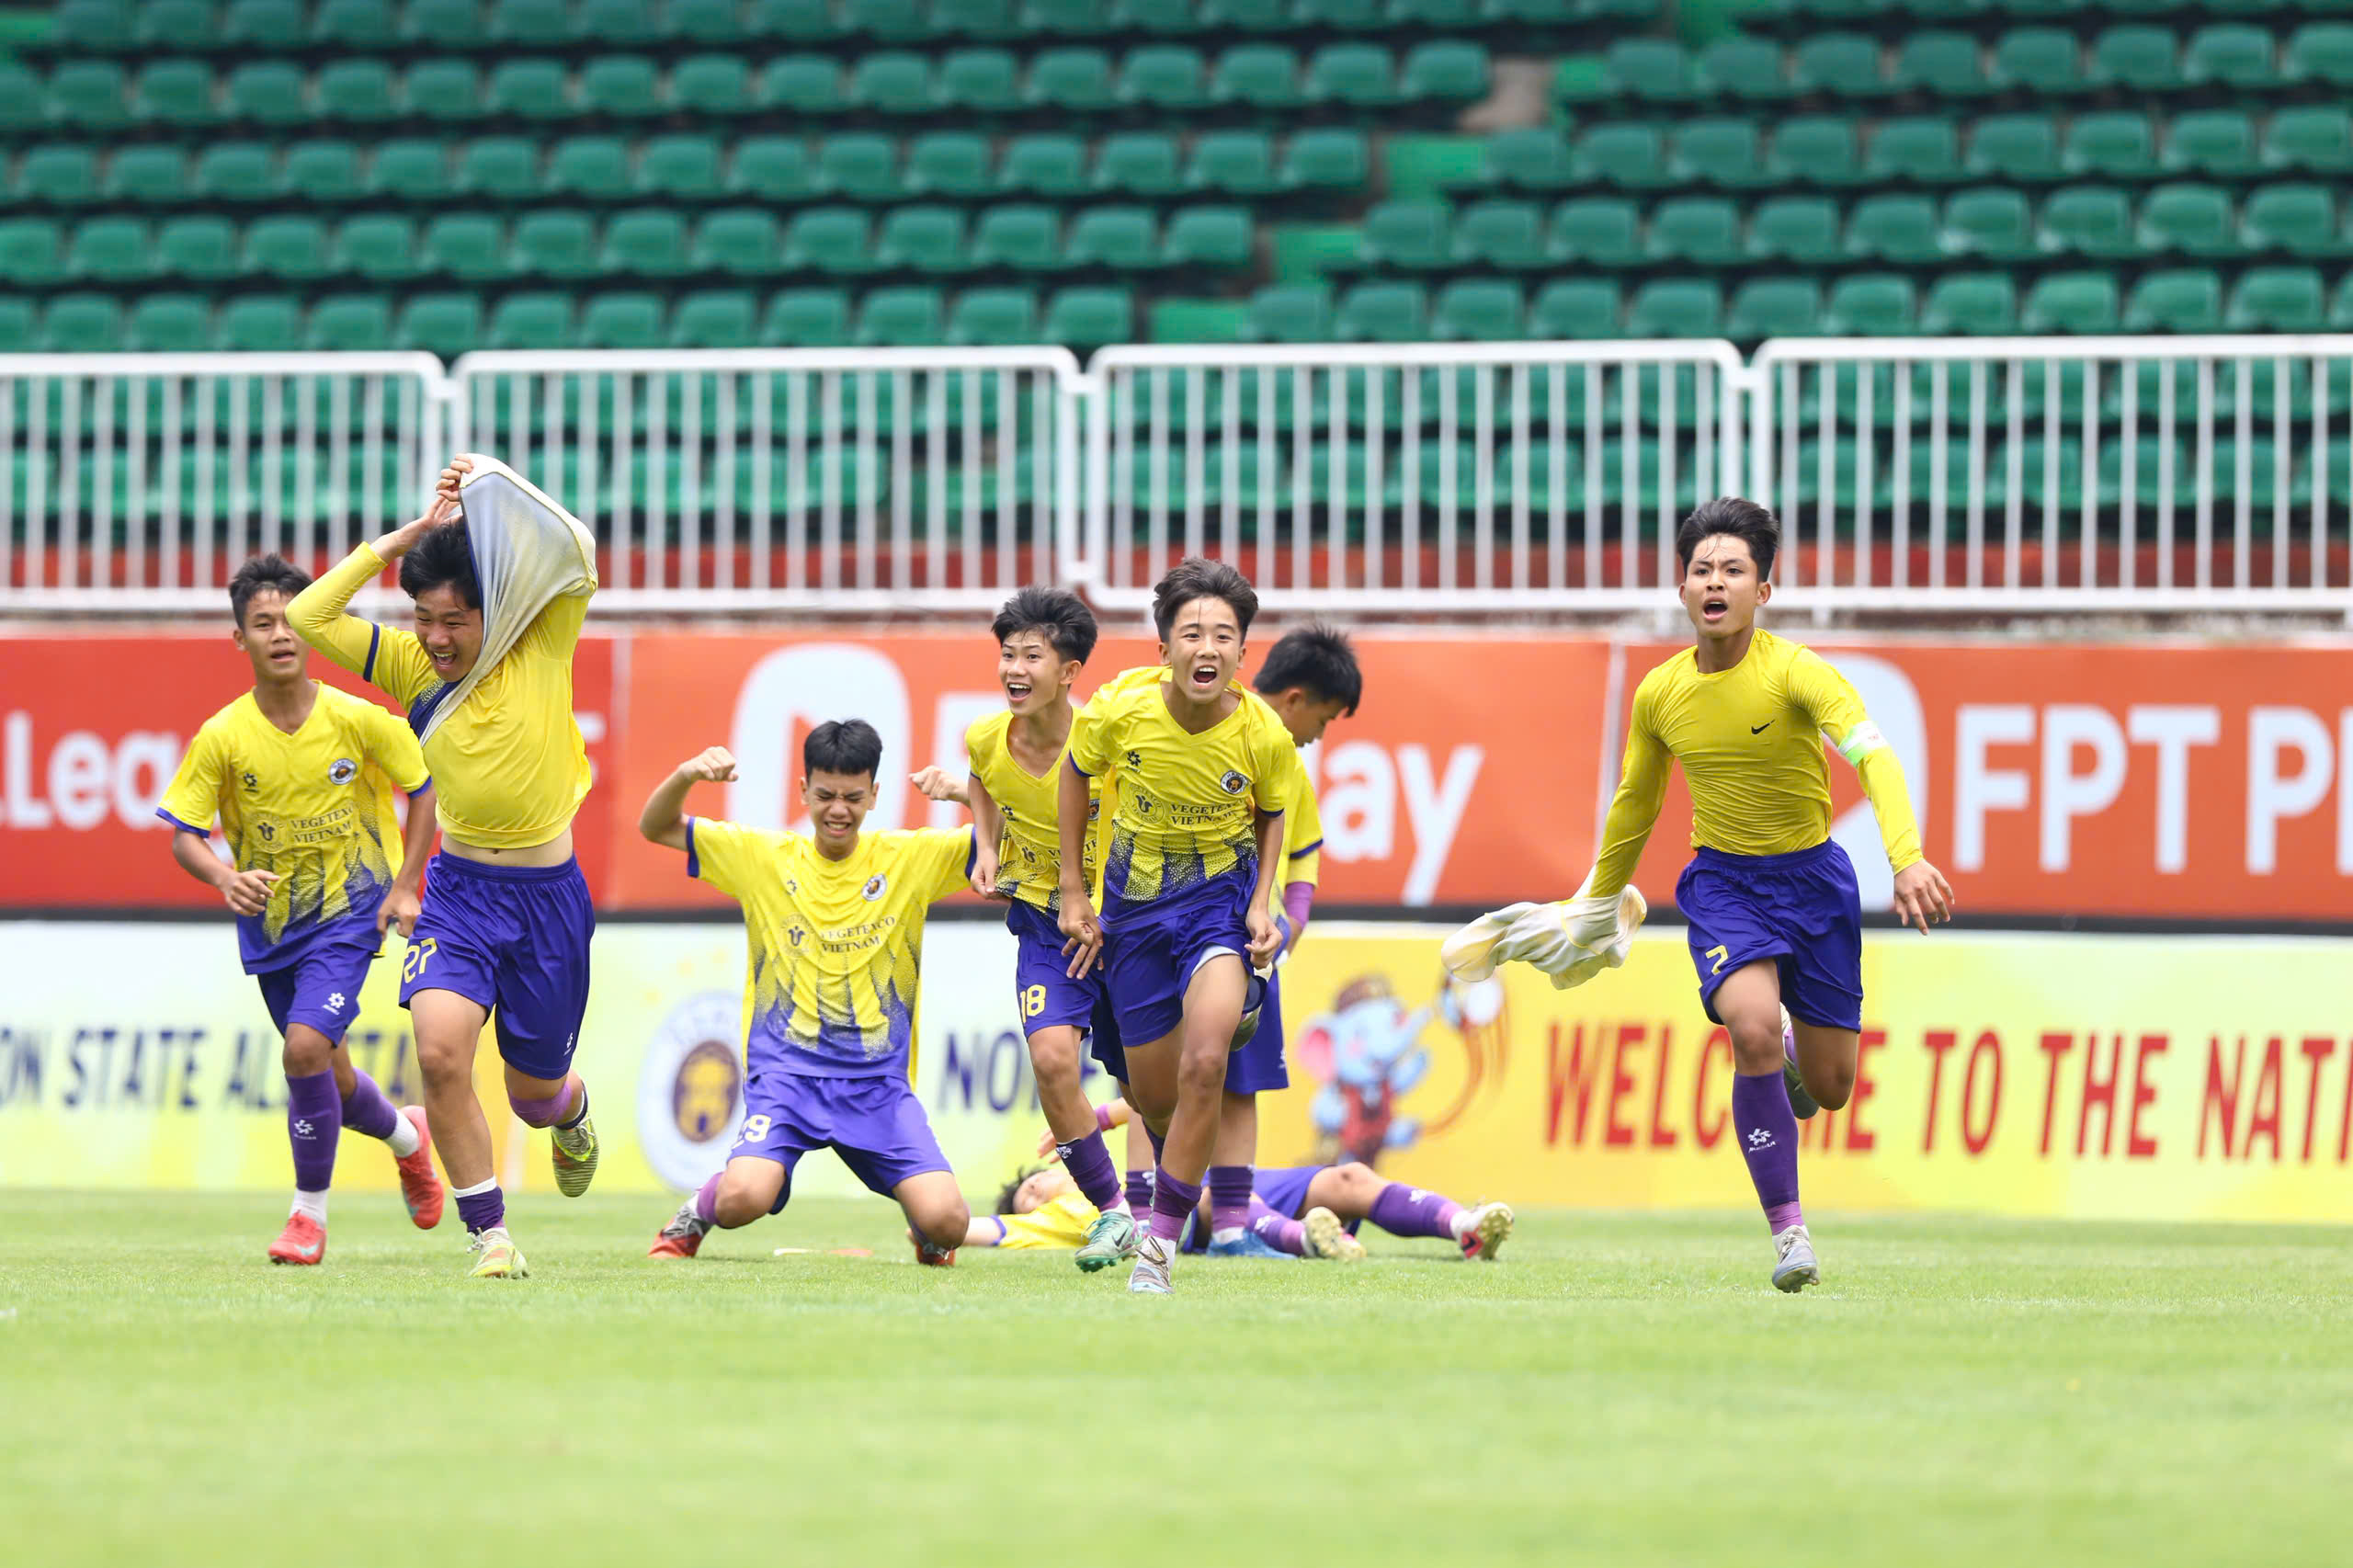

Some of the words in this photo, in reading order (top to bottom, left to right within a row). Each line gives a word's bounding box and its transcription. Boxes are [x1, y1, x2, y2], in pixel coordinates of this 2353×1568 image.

[1954, 705, 2222, 874] FPT
[290, 808, 354, 830] VEGETEX
[404, 937, 438, 983] 27
[822, 936, 881, 952] VIETNAM
[1705, 944, 1729, 976] 7
[1019, 983, 1047, 1023] 18
[63, 1024, 208, 1112] STATE
[937, 1028, 1040, 1114] NO
[1547, 1022, 1887, 1154] WELCE
[1921, 1029, 2004, 1156] TO
[2038, 1033, 2170, 1158] THE
